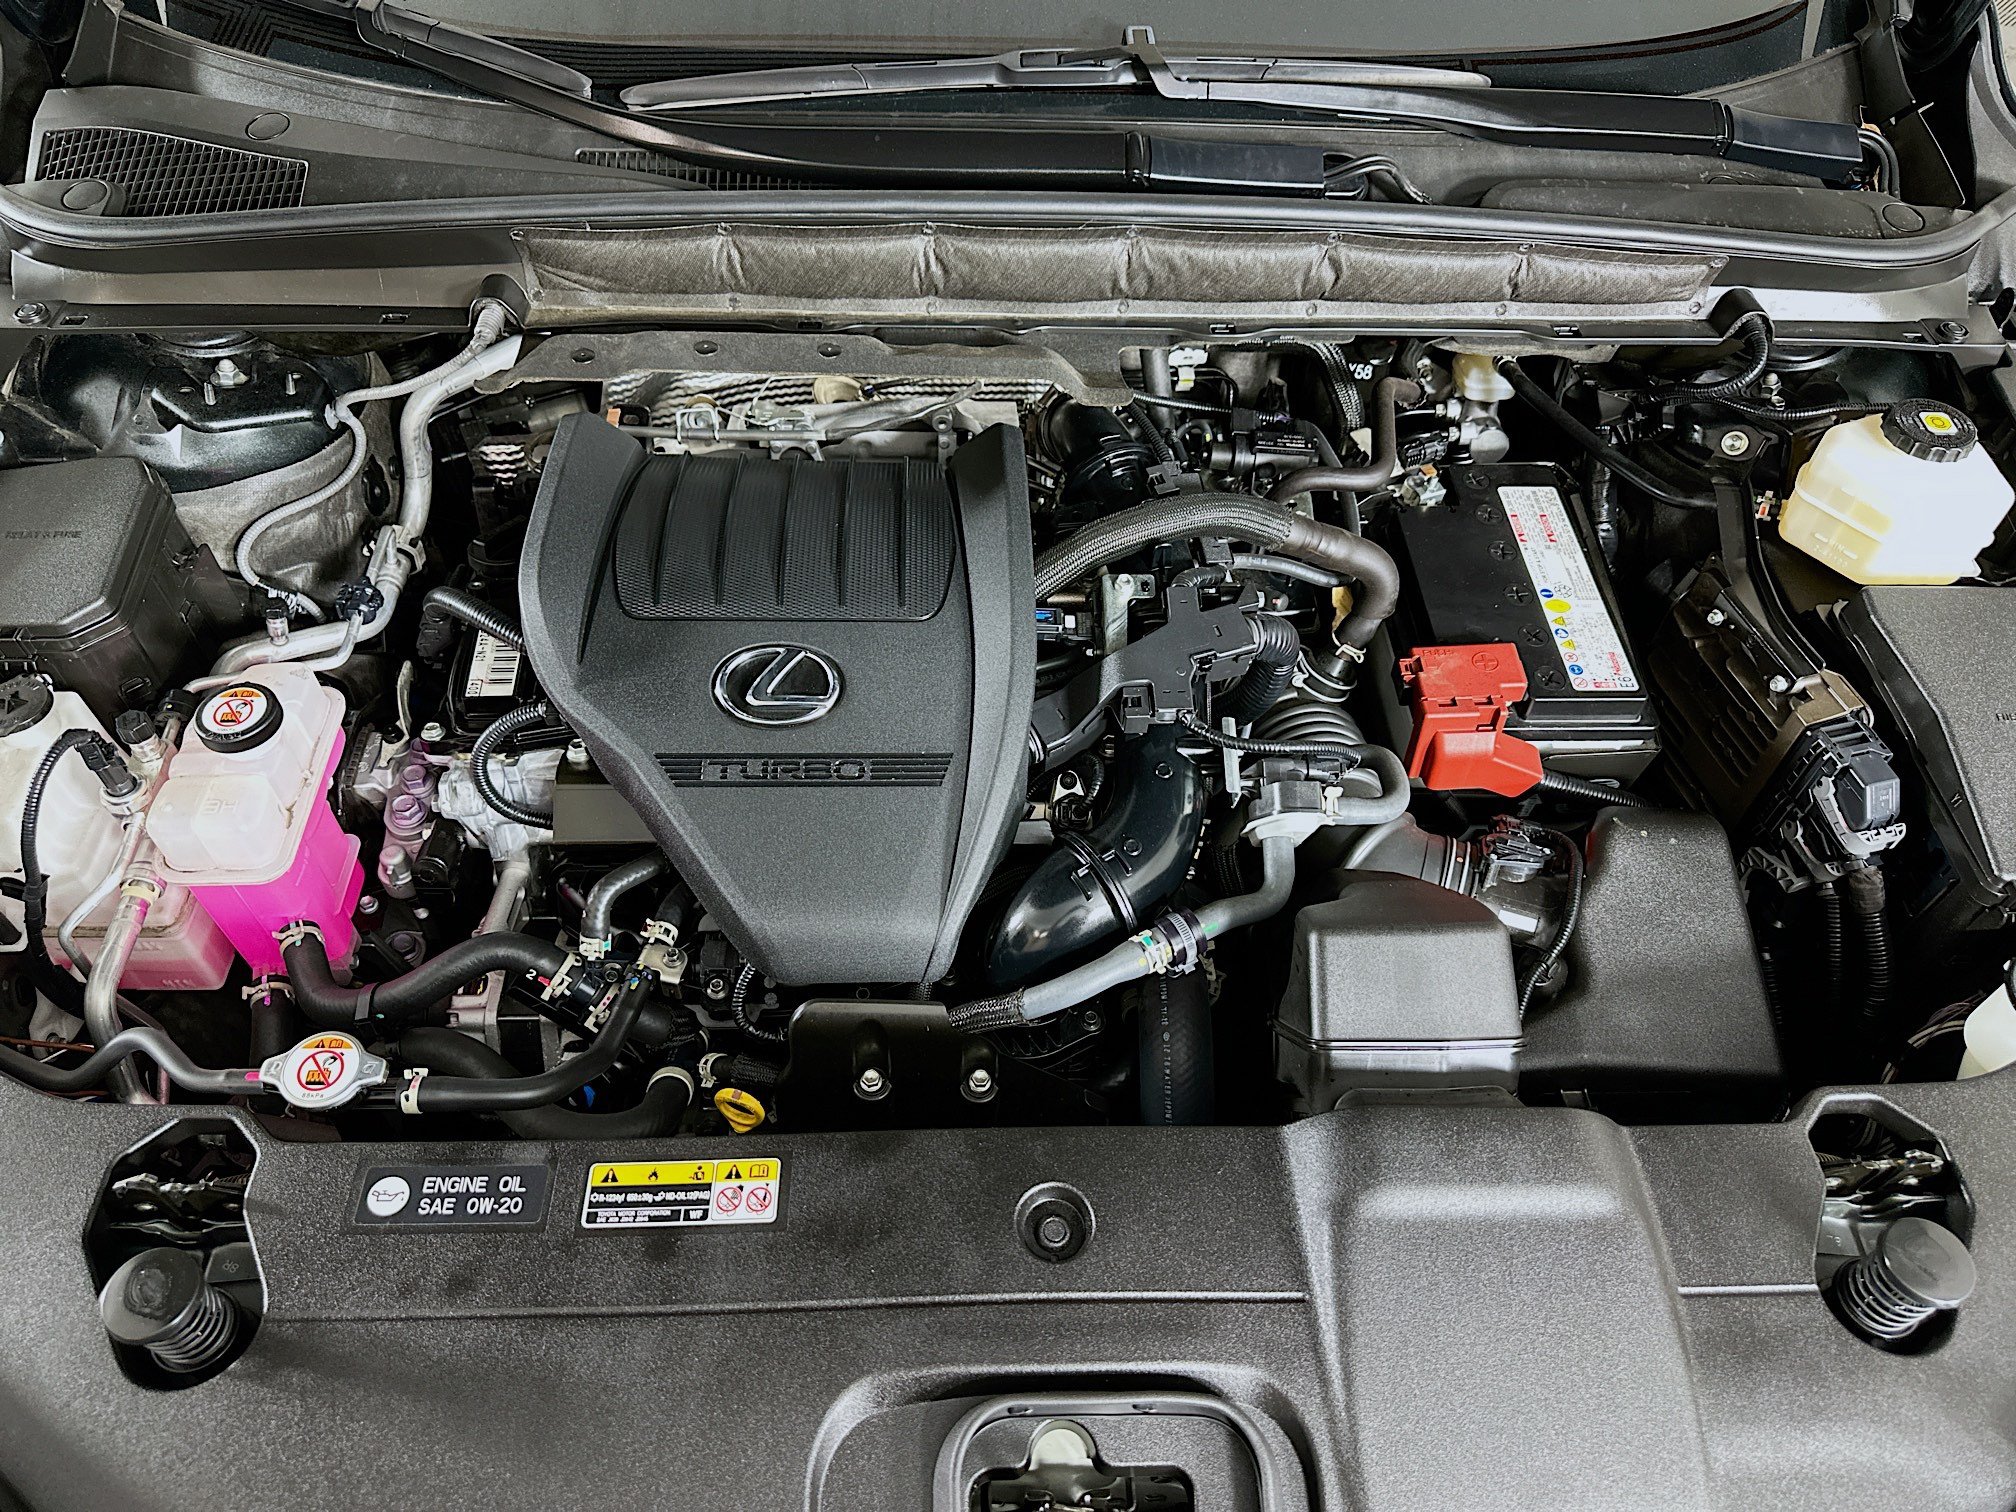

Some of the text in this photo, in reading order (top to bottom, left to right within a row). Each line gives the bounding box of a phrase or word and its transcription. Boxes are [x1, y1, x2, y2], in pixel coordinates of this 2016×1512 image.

[702, 759, 866, 780] TURBO
[526, 968, 536, 980] 2
[422, 1176, 527, 1194] ENGINE OIL
[417, 1197, 523, 1215] SAE 0W-20
[689, 1209, 703, 1220] WF
